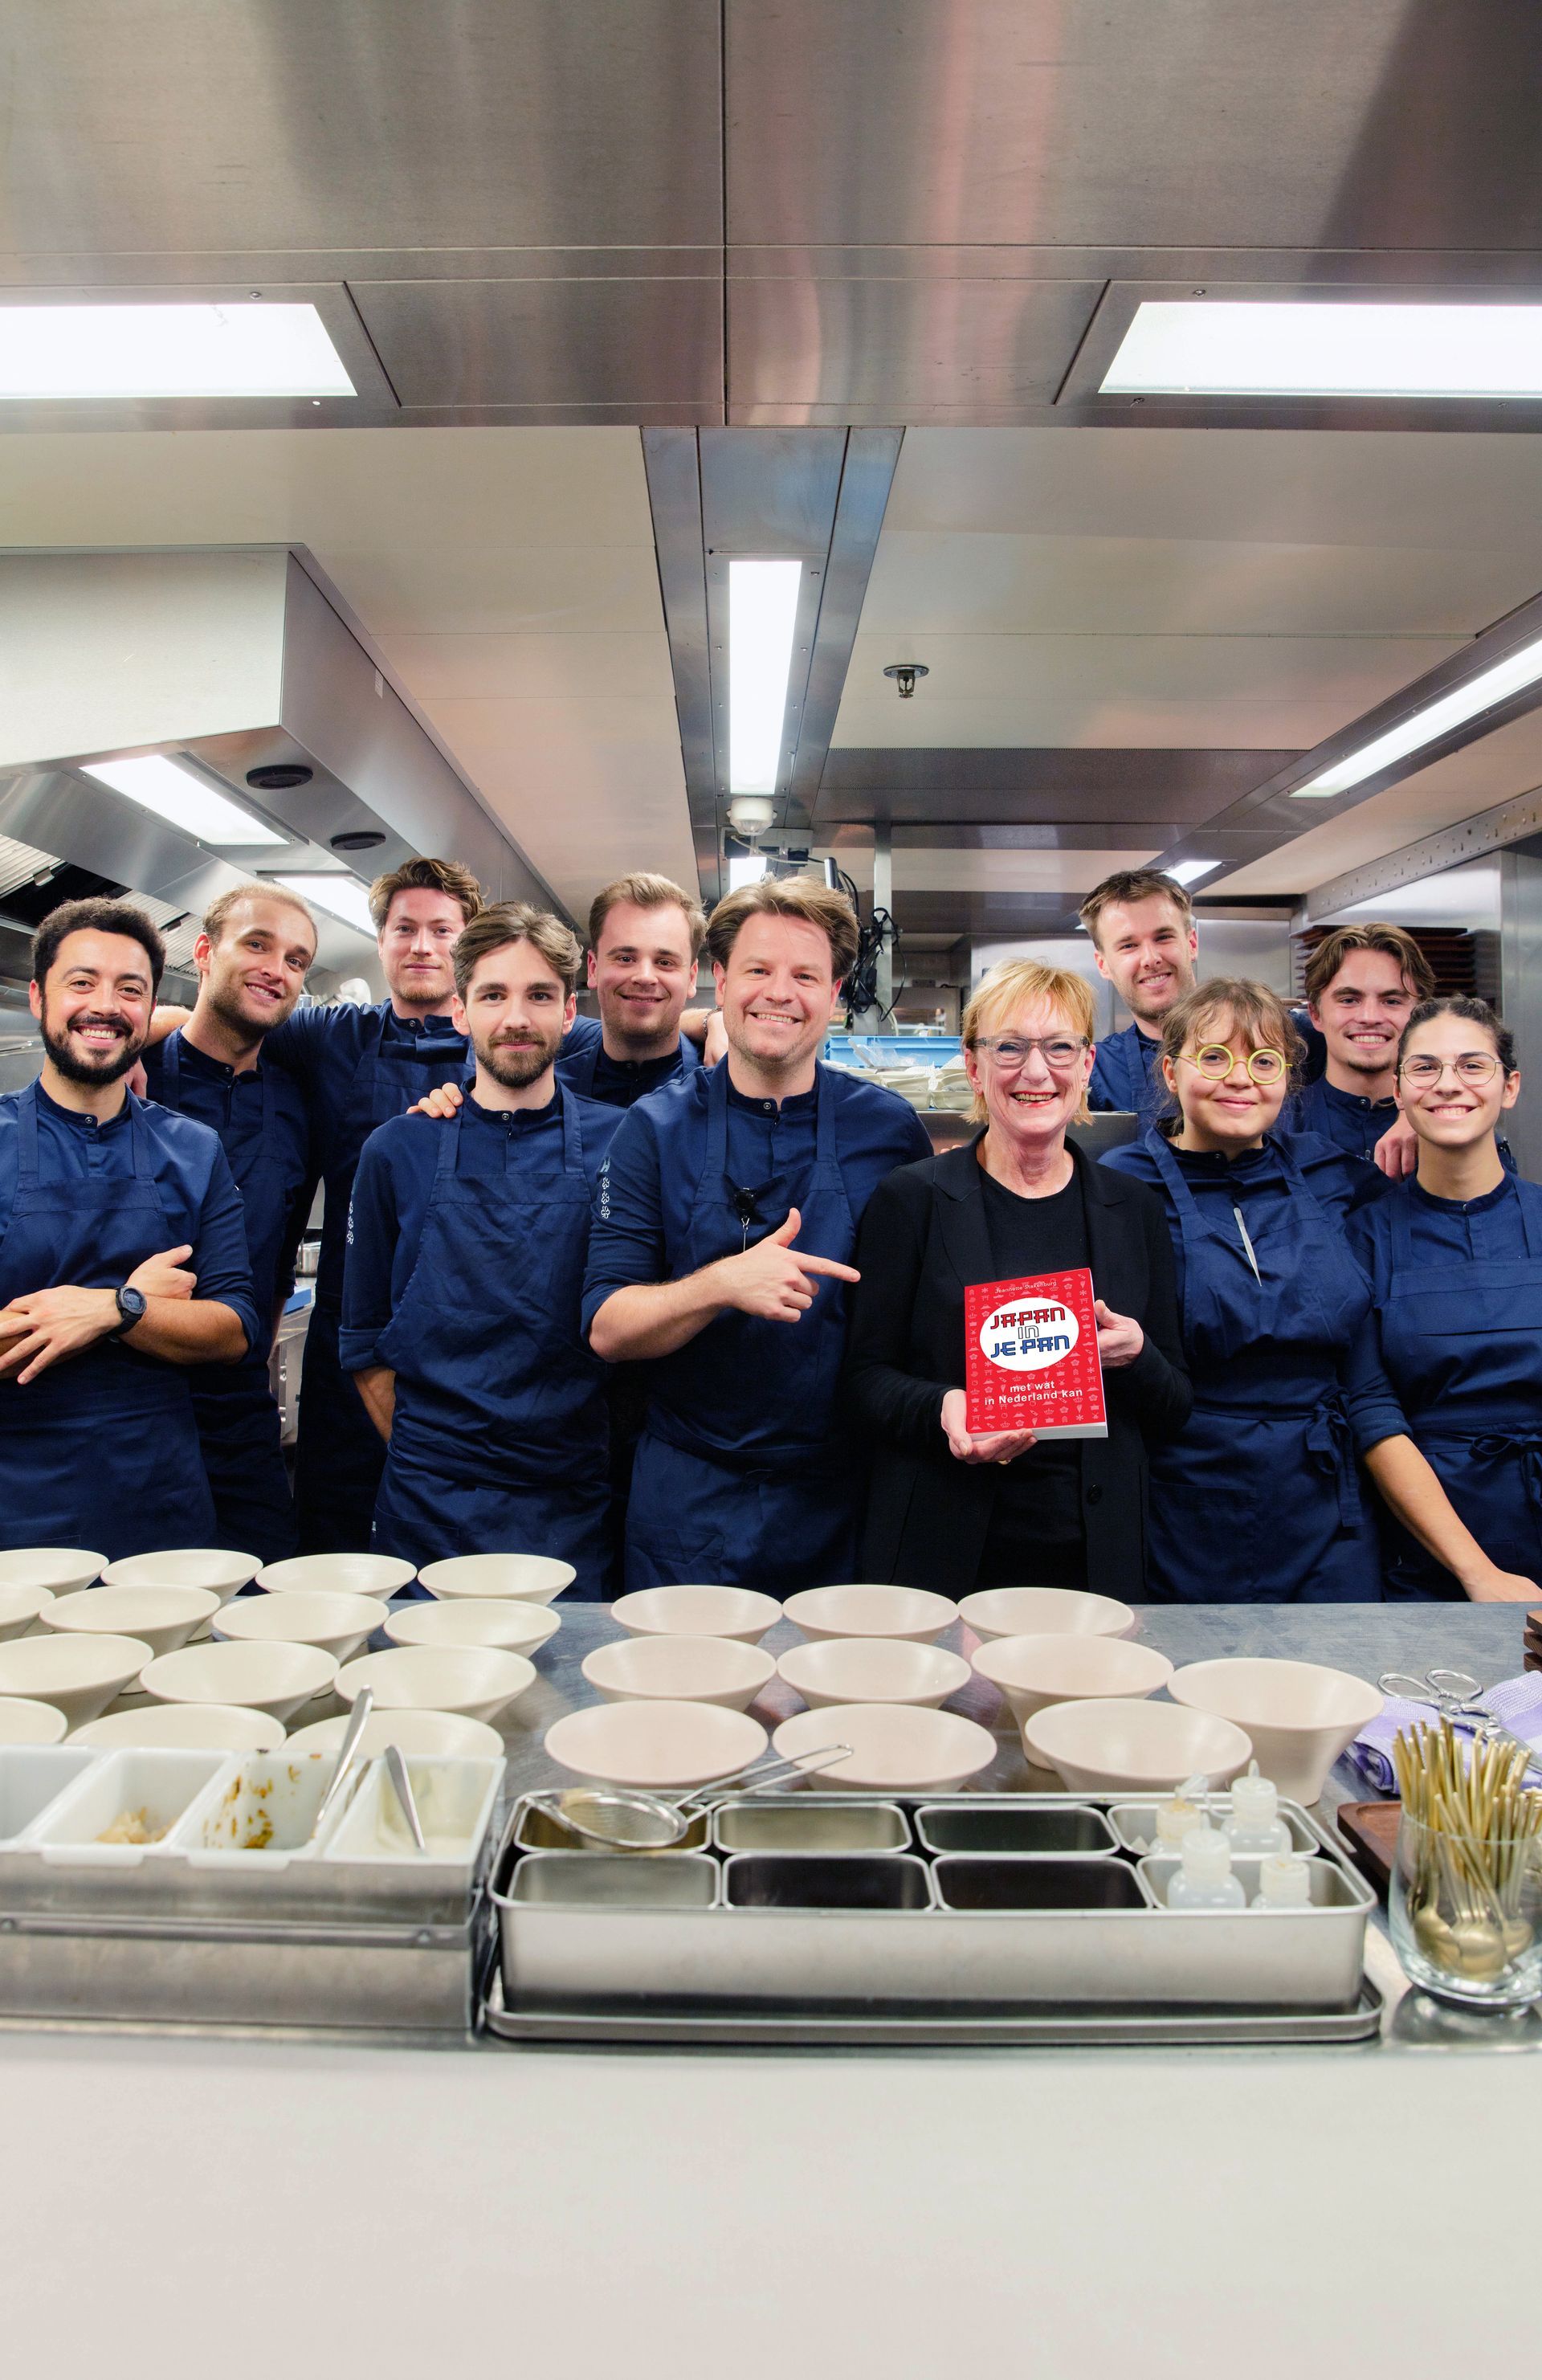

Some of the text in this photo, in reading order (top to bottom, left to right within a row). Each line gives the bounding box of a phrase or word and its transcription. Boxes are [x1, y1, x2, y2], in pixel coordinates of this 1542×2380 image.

[995, 1286, 1022, 1294] Jeannette
[990, 1306, 1066, 1330] JAPAN
[990, 1334, 1070, 1358] JE PAN
[1010, 1381, 1055, 1393] met wat
[984, 1388, 1083, 1406] in Nederland kan
